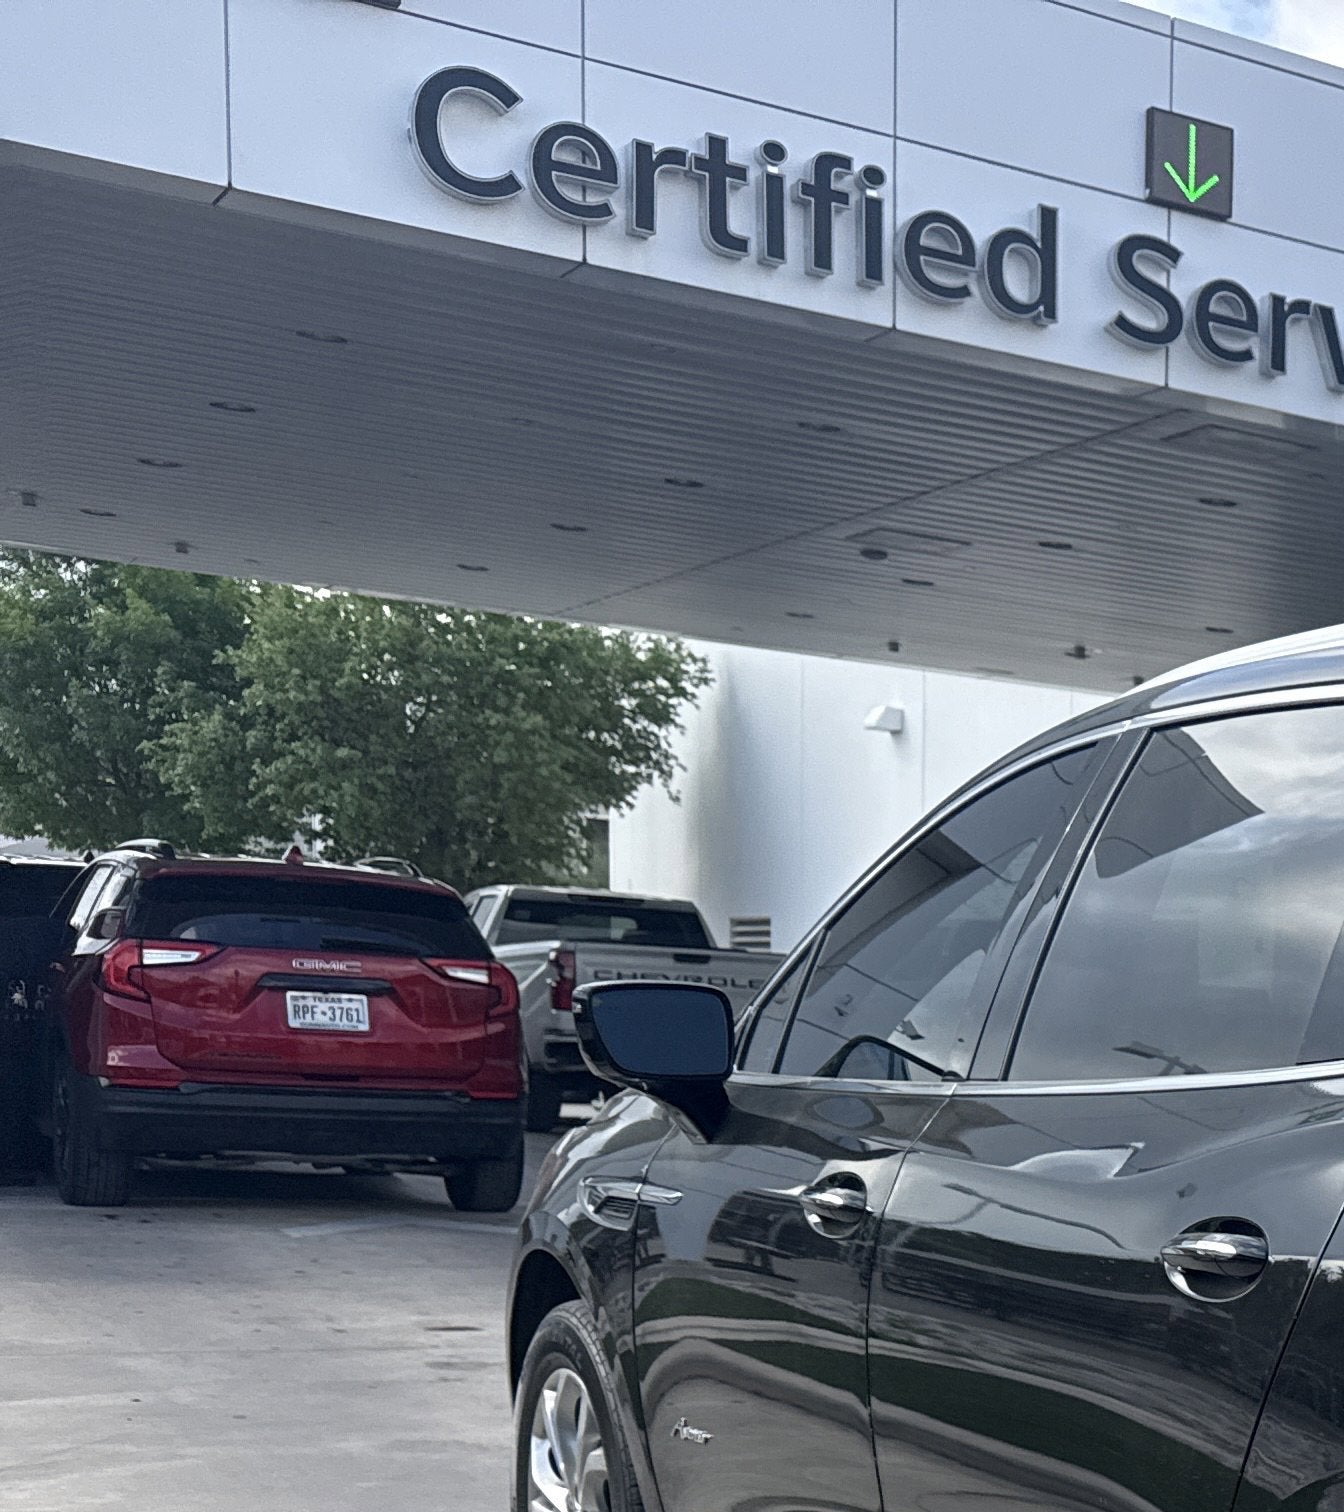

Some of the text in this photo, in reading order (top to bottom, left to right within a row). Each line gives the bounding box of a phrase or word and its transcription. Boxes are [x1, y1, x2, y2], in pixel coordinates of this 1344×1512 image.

[408, 65, 1060, 326] Certified
[292, 958, 362, 973] GMC
[593, 969, 766, 990] CHEVROLE
